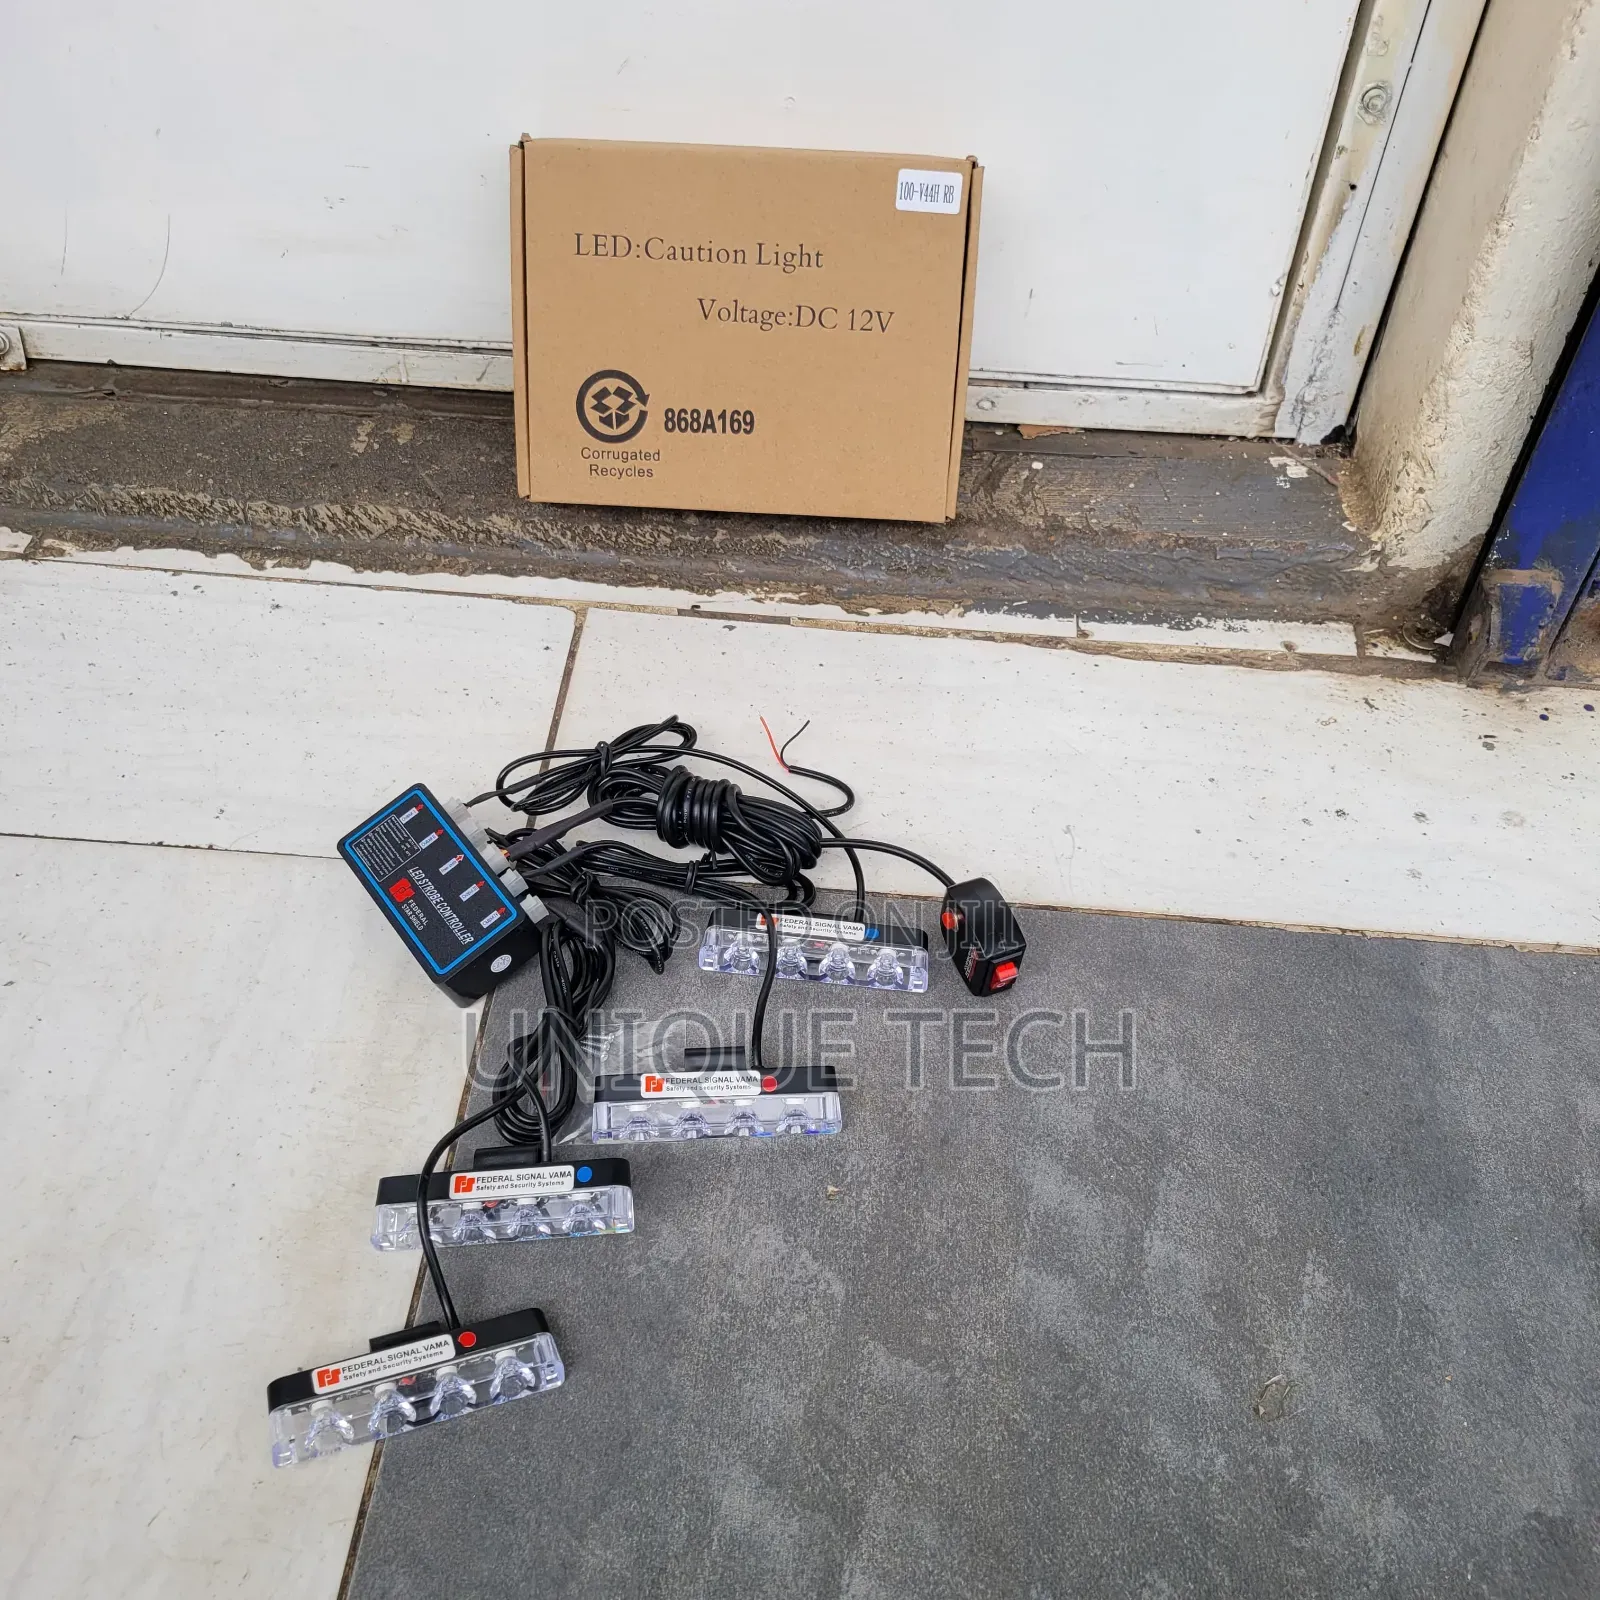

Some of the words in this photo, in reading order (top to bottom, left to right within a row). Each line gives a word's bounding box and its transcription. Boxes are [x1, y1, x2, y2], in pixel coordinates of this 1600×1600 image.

[900, 181, 941, 203] 100-V44H
[943, 184, 955, 203] RB
[574, 232, 748, 265] LED:Caution
[755, 242, 824, 274] Light
[697, 298, 838, 332] Voltage:DC
[847, 308, 895, 333] 12V
[664, 408, 755, 435] 868A169
[581, 446, 661, 463] Corrugated
[589, 464, 654, 480] Recycles
[401, 903, 413, 916] STAR
[409, 914, 424, 931] SHIELD
[408, 866, 425, 881] LED
[418, 878, 444, 905] STROBE
[437, 902, 475, 945] CONTROLLER
[408, 899, 429, 926] FEDERAL
[779, 917, 813, 927] FEDERAL
[814, 921, 841, 930] SIGNAL
[842, 924, 864, 932] VAMA
[665, 1077, 702, 1085] FEDERAL
[736, 1075, 759, 1083] VAMA
[476, 1175, 514, 1184] FEDERAL
[516, 1173, 547, 1181] SIGNAL
[548, 1171, 572, 1179] VAMA
[510, 1181, 536, 1189] Security
[341, 1358, 385, 1374] FEDERAL
[387, 1348, 422, 1362] SIGNAL
[422, 1340, 450, 1352] VAMA
[343, 1370, 367, 1381] Safety
[368, 1366, 381, 1375] and
[382, 1359, 412, 1370] Security
[413, 1350, 444, 1362] Systems
